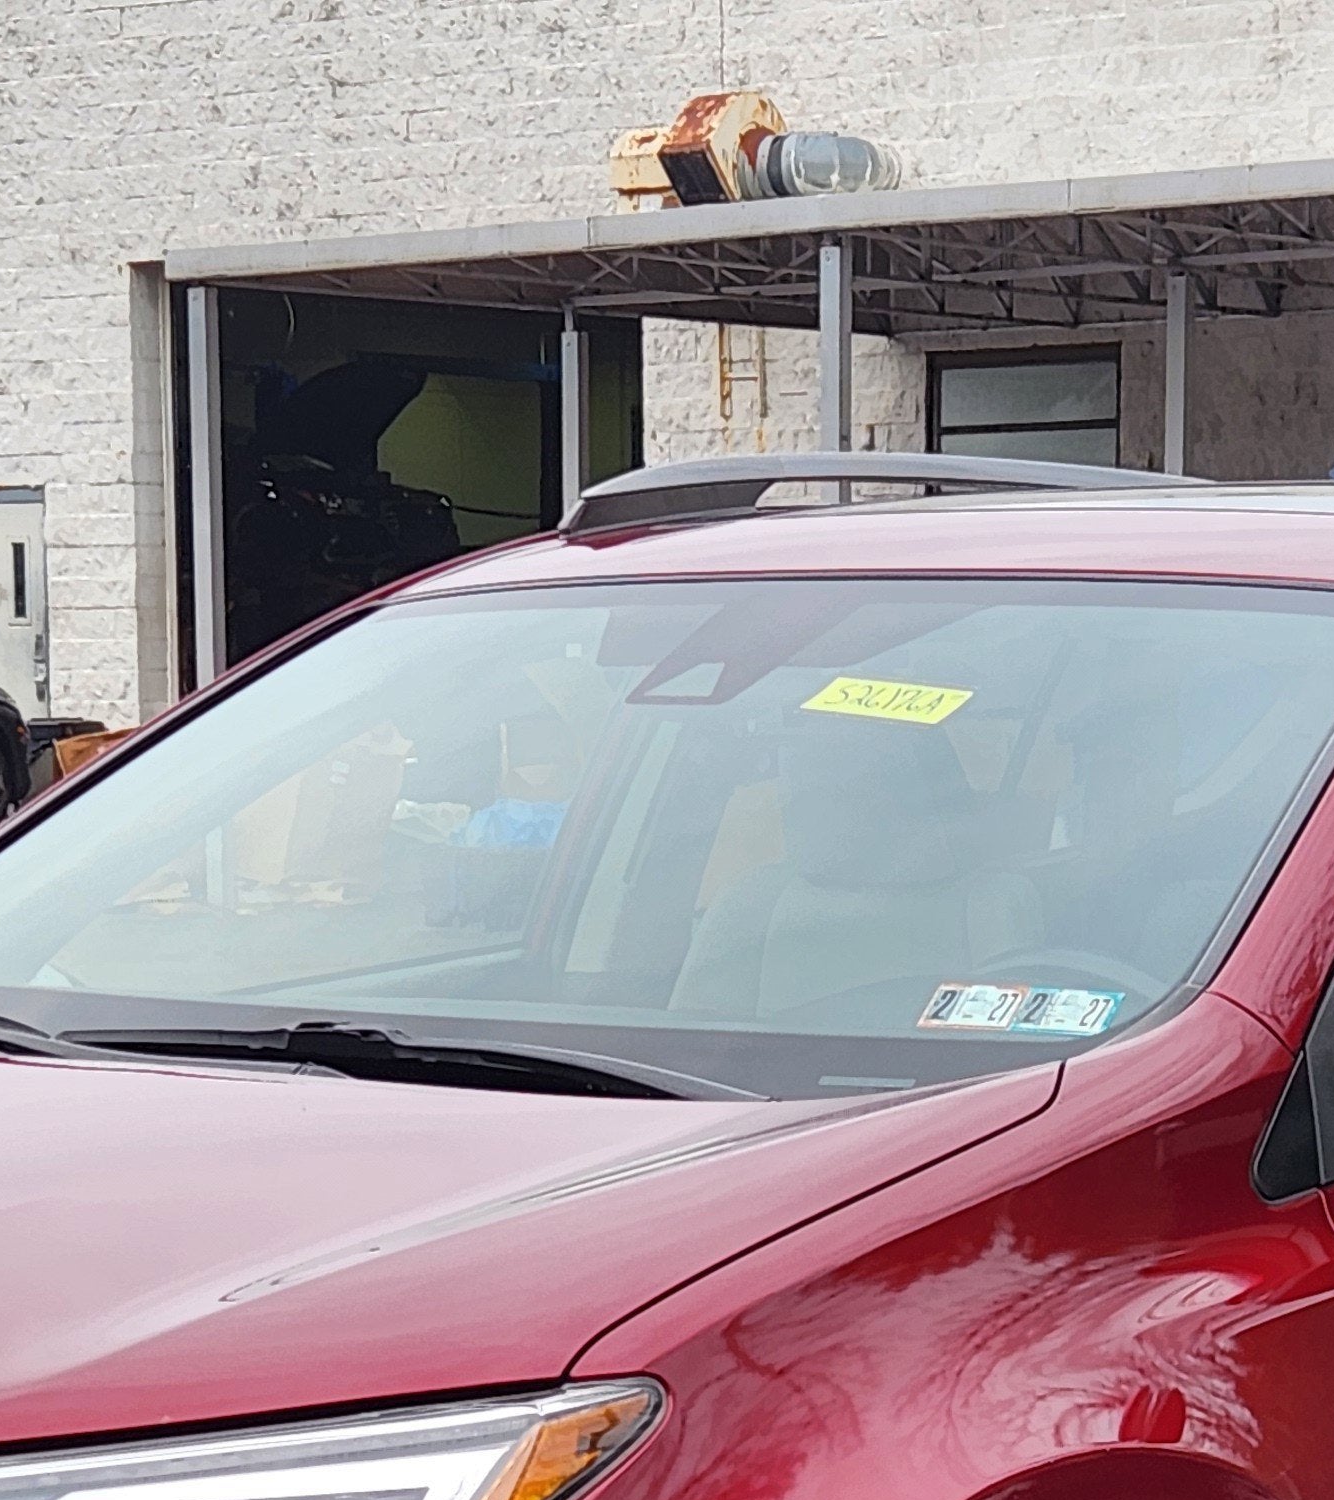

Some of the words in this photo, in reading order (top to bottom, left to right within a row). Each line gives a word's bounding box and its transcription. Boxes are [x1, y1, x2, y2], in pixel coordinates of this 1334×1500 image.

[930, 990, 957, 1019] 2
[987, 993, 1019, 1024] 27
[1023, 993, 1048, 1023] 2
[1079, 998, 1110, 1029] 27
